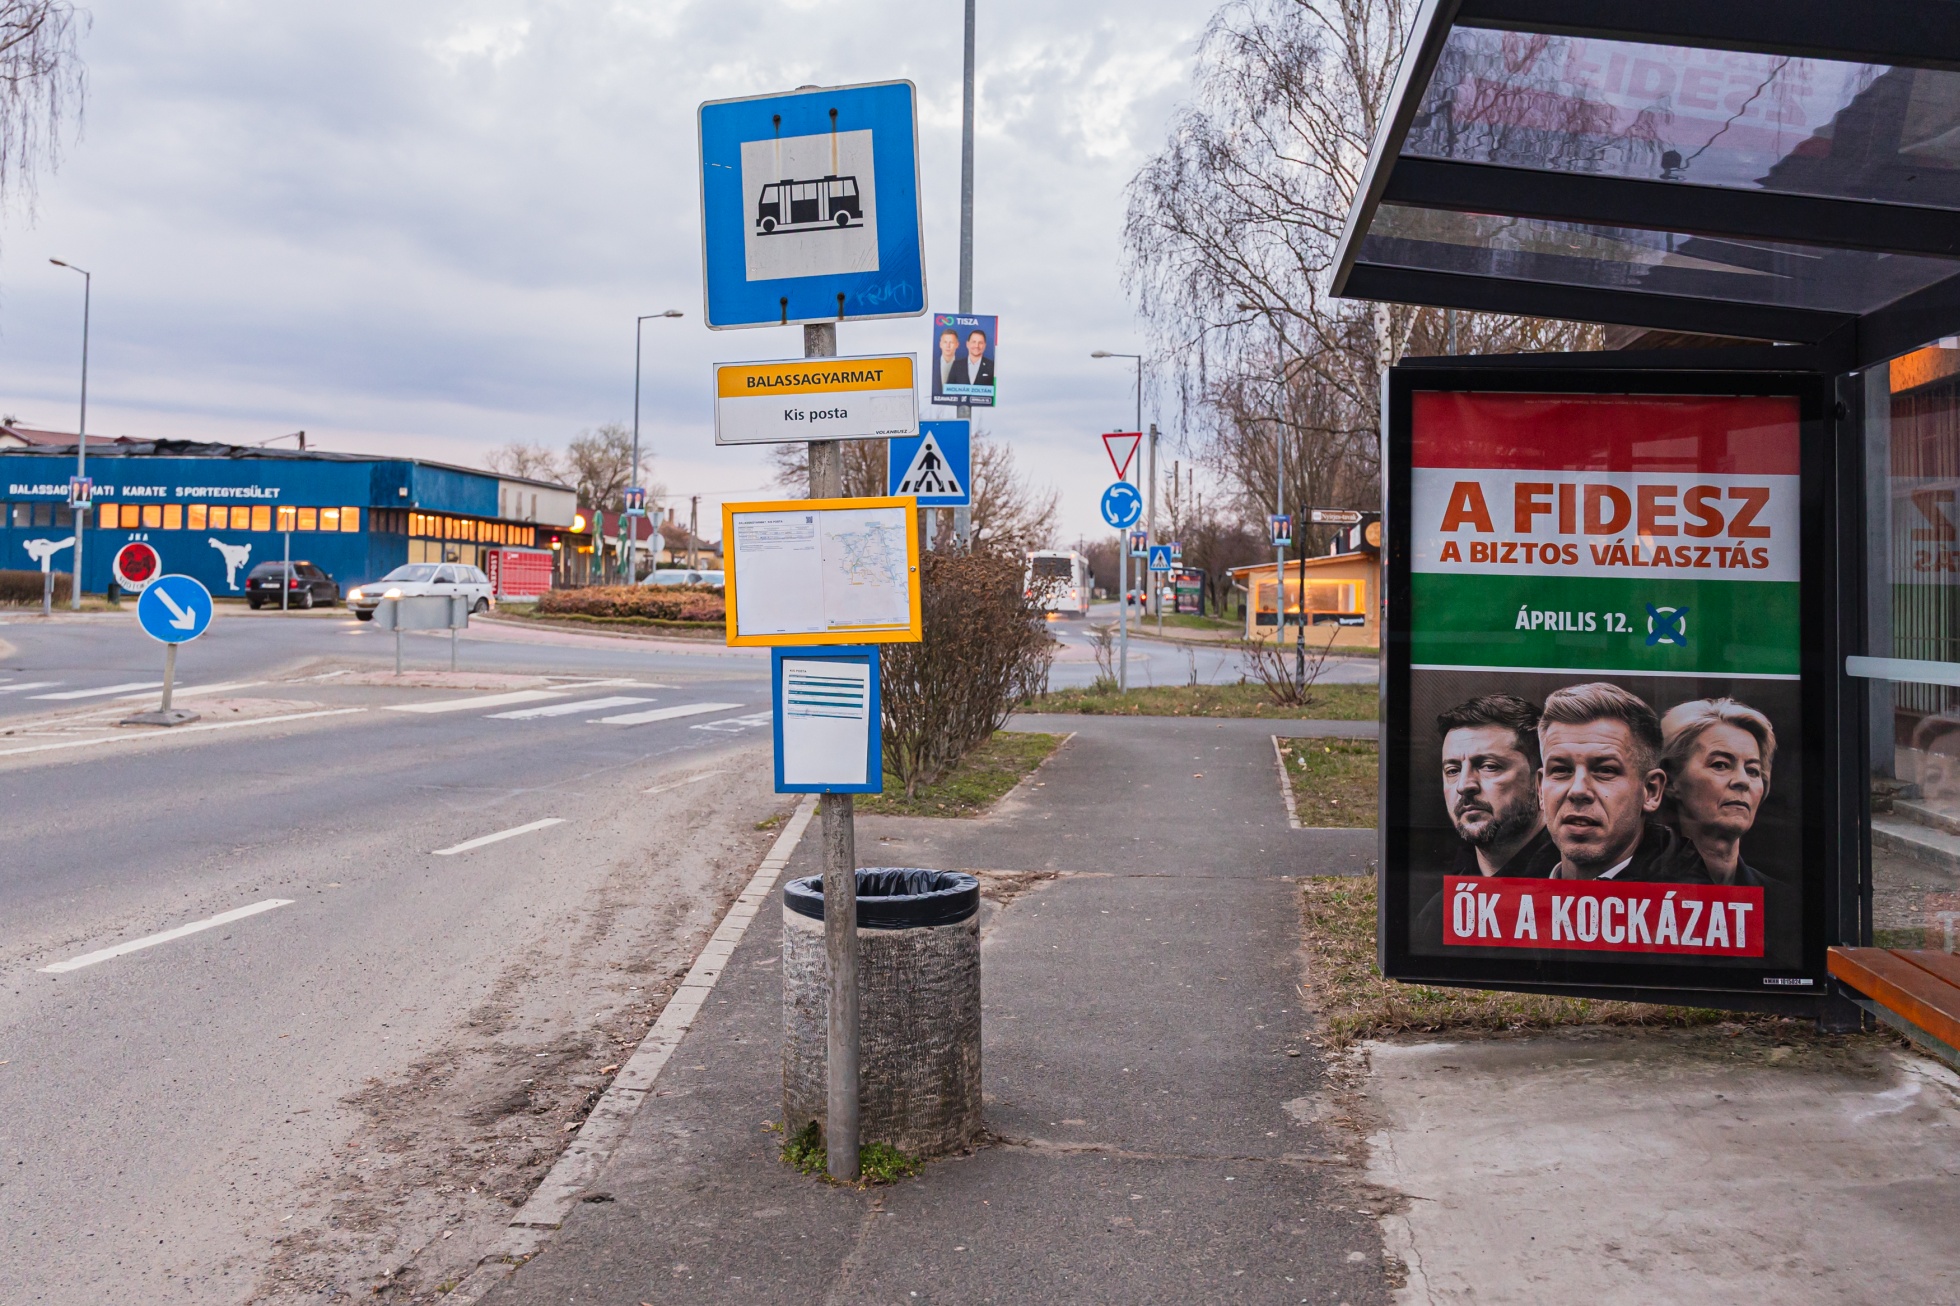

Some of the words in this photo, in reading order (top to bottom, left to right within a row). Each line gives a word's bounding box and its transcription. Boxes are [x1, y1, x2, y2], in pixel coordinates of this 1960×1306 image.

[956, 317, 979, 326] TISZA
[746, 369, 884, 389] BALASSAGYARMAT
[784, 408, 805, 421] Kis
[809, 407, 848, 423] posta
[9, 483, 115, 496] BALASSAGMATI
[122, 485, 167, 497] KARATE
[175, 484, 281, 498] SPORTEGYESÜLET
[1439, 481, 1495, 533] A
[1514, 481, 1771, 539] FIDESZ
[1439, 541, 1463, 563] A
[1469, 541, 1579, 565] BIZTOS
[1589, 538, 1770, 569] VÁLASZTÁS
[1514, 604, 1597, 632] ÁPRILIS
[1602, 612, 1633, 633] 12.
[1452, 882, 1502, 939] ŐK
[1513, 893, 1538, 940] A
[1551, 890, 1754, 948] KOCKÁZAT
